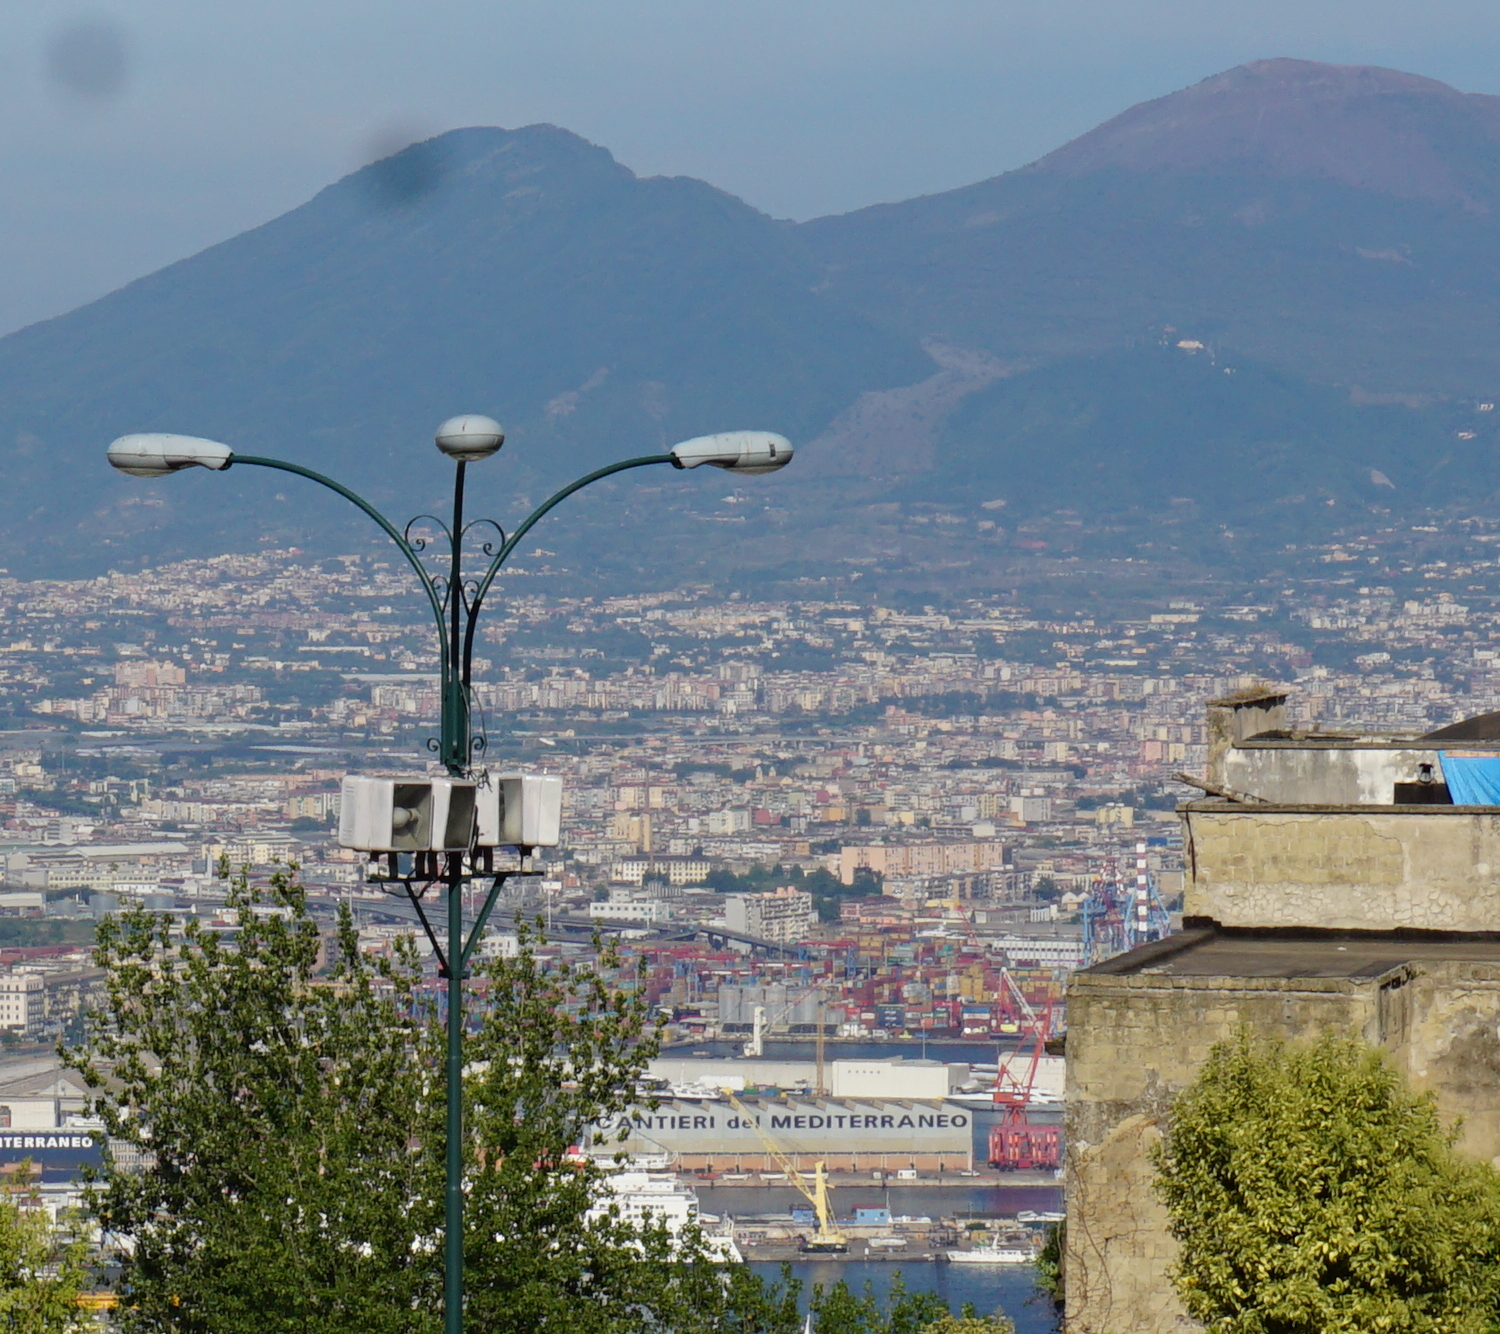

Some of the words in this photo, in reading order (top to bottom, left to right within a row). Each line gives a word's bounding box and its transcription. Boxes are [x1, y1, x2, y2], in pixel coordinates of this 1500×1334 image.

[595, 1115, 715, 1130] CANTIERI
[727, 1114, 760, 1129] del
[771, 1114, 968, 1129] MEDITERRANEO
